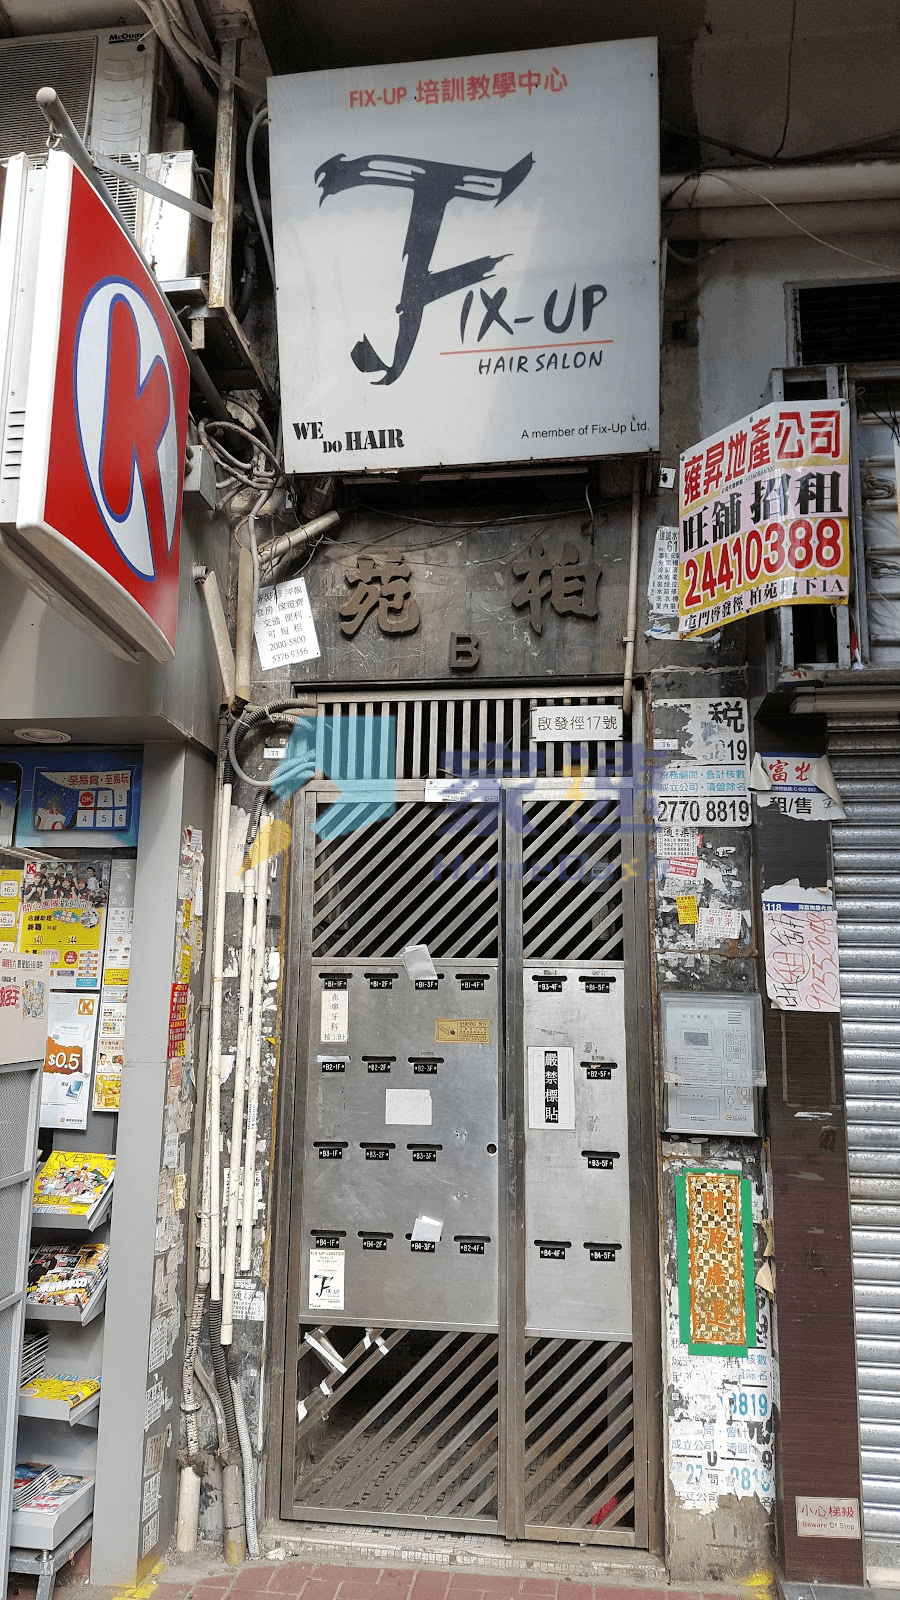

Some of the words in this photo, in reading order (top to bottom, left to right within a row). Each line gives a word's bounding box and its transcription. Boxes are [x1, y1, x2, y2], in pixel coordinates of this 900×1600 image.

[349, 87, 407, 108] FIX-UP
[415, 67, 569, 104] 培訓教學中心
[478, 355, 529, 375] HAIR
[535, 350, 603, 371] SALON
[292, 421, 323, 440] WE
[323, 440, 342, 453] DO
[345, 429, 405, 450] HAIR
[521, 430, 530, 439] A
[532, 427, 575, 439] member
[578, 425, 589, 435] of
[591, 422, 627, 435] Fix-Up
[630, 420, 650, 432] Ltd.
[685, 518, 841, 607] 24410388
[449, 631, 480, 671] B
[658, 801, 700, 822] 2770
[706, 800, 750, 822] 8819
[47, 1051, 81, 1071] $0.5
[545, 1053, 558, 1121] 嚴禁標貼
[801, 1505, 854, 1518] 小心梯級
[802, 1521, 828, 1529] Beware
[840, 1523, 855, 1531] Step
